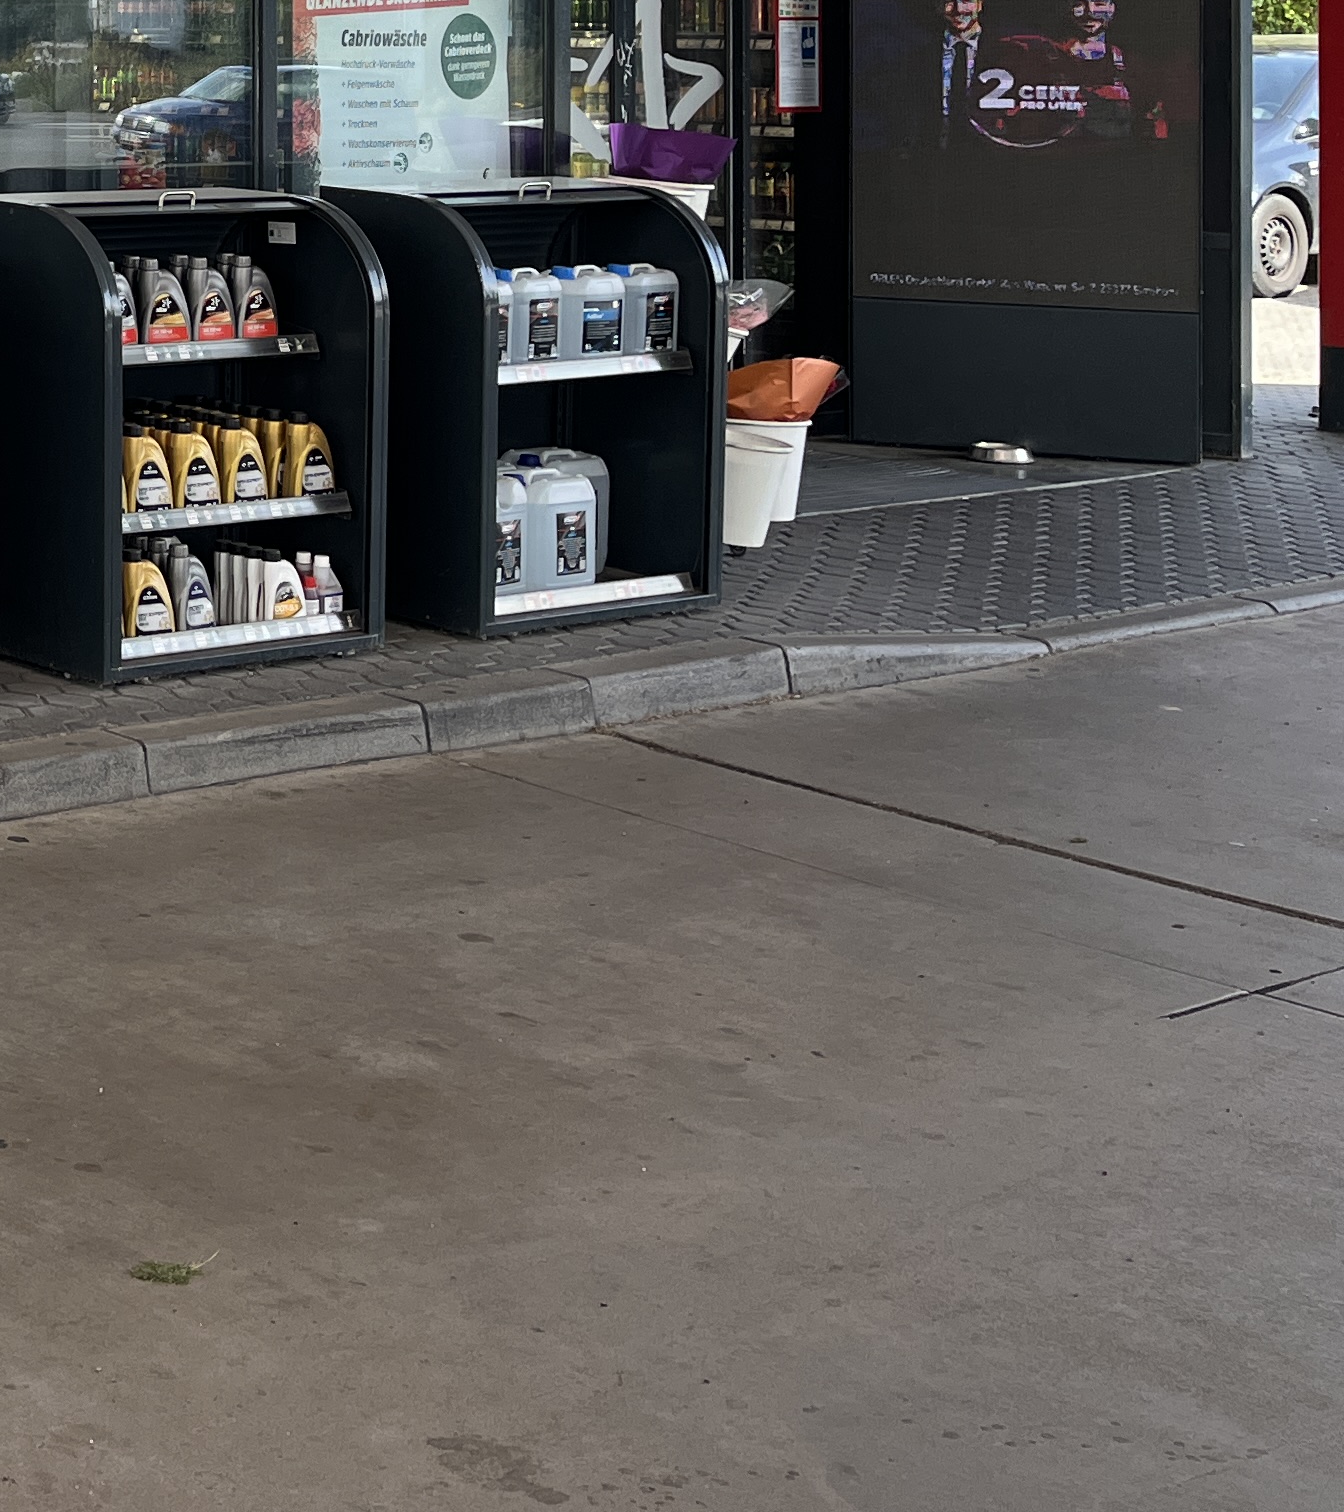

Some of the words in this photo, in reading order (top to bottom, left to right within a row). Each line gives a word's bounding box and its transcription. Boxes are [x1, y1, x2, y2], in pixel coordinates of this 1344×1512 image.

[341, 28, 427, 47] Cabriowäsche
[347, 79, 395, 90] Felgenwäsche
[979, 68, 1016, 109] 2
[1018, 85, 1080, 100] CENT
